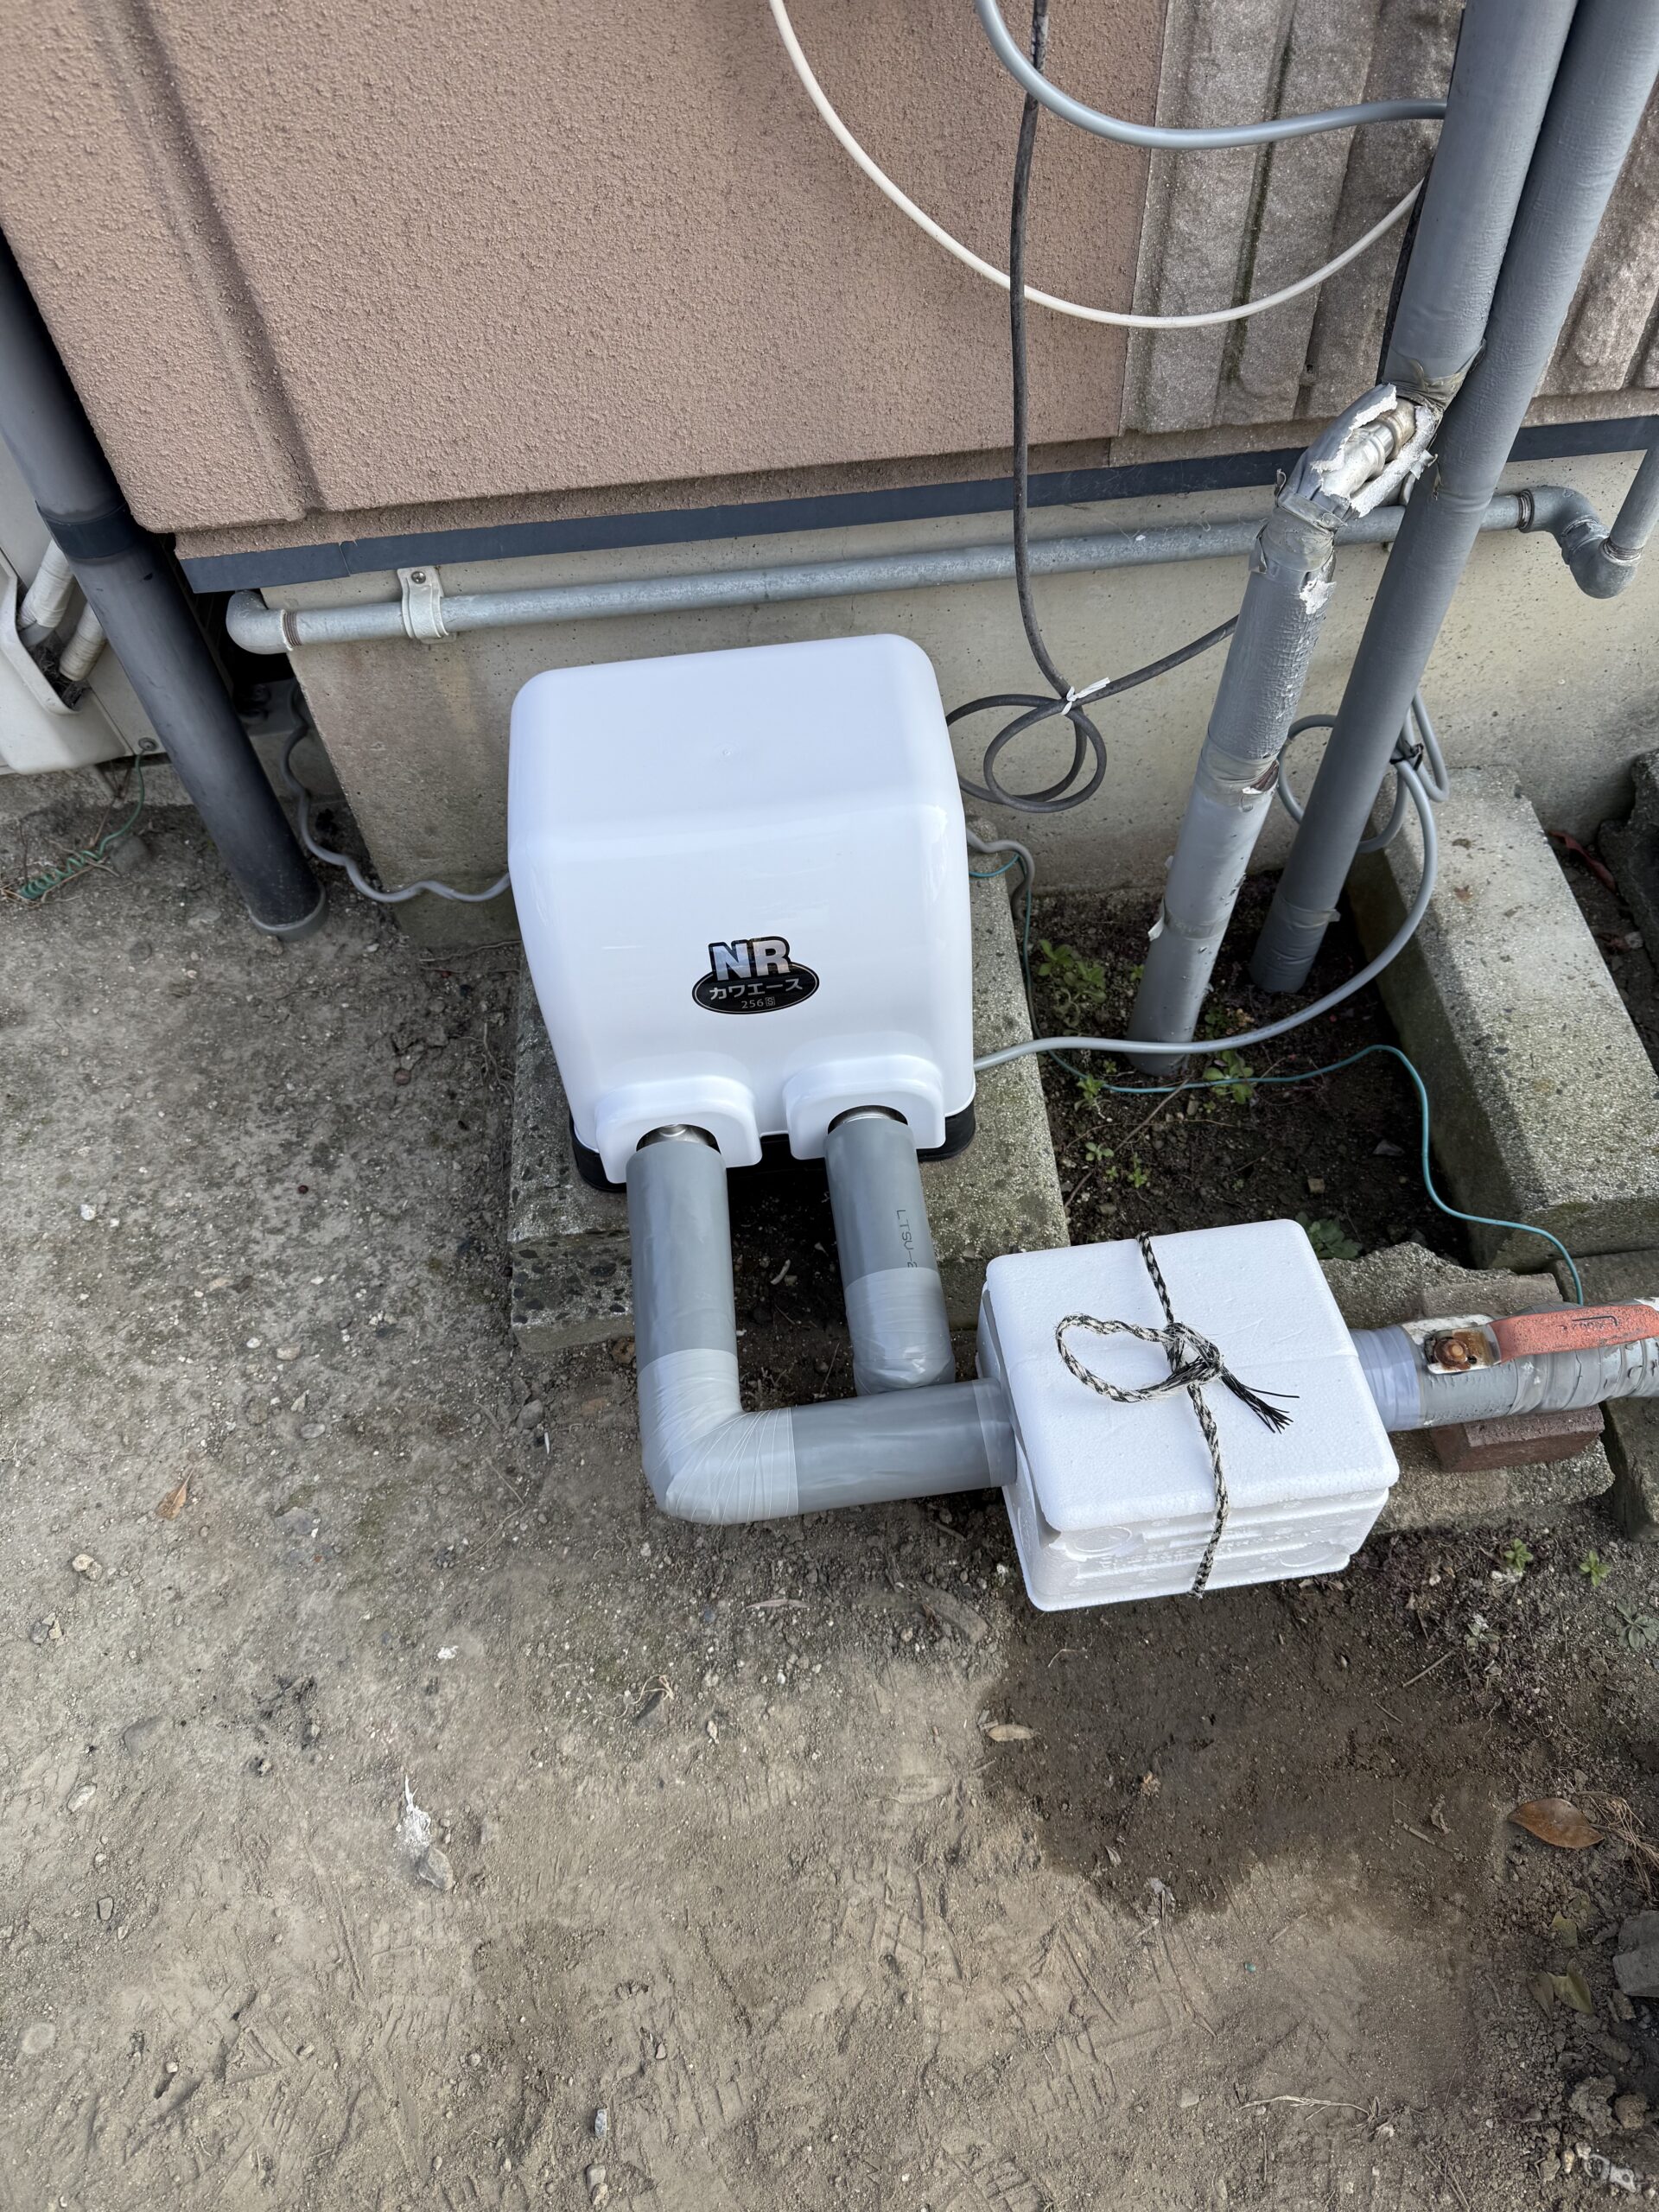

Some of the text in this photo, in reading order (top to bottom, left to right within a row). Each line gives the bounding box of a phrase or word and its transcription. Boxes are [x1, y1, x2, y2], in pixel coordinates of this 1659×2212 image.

[711, 938, 791, 982] NR
[709, 977, 804, 1001] カワエース
